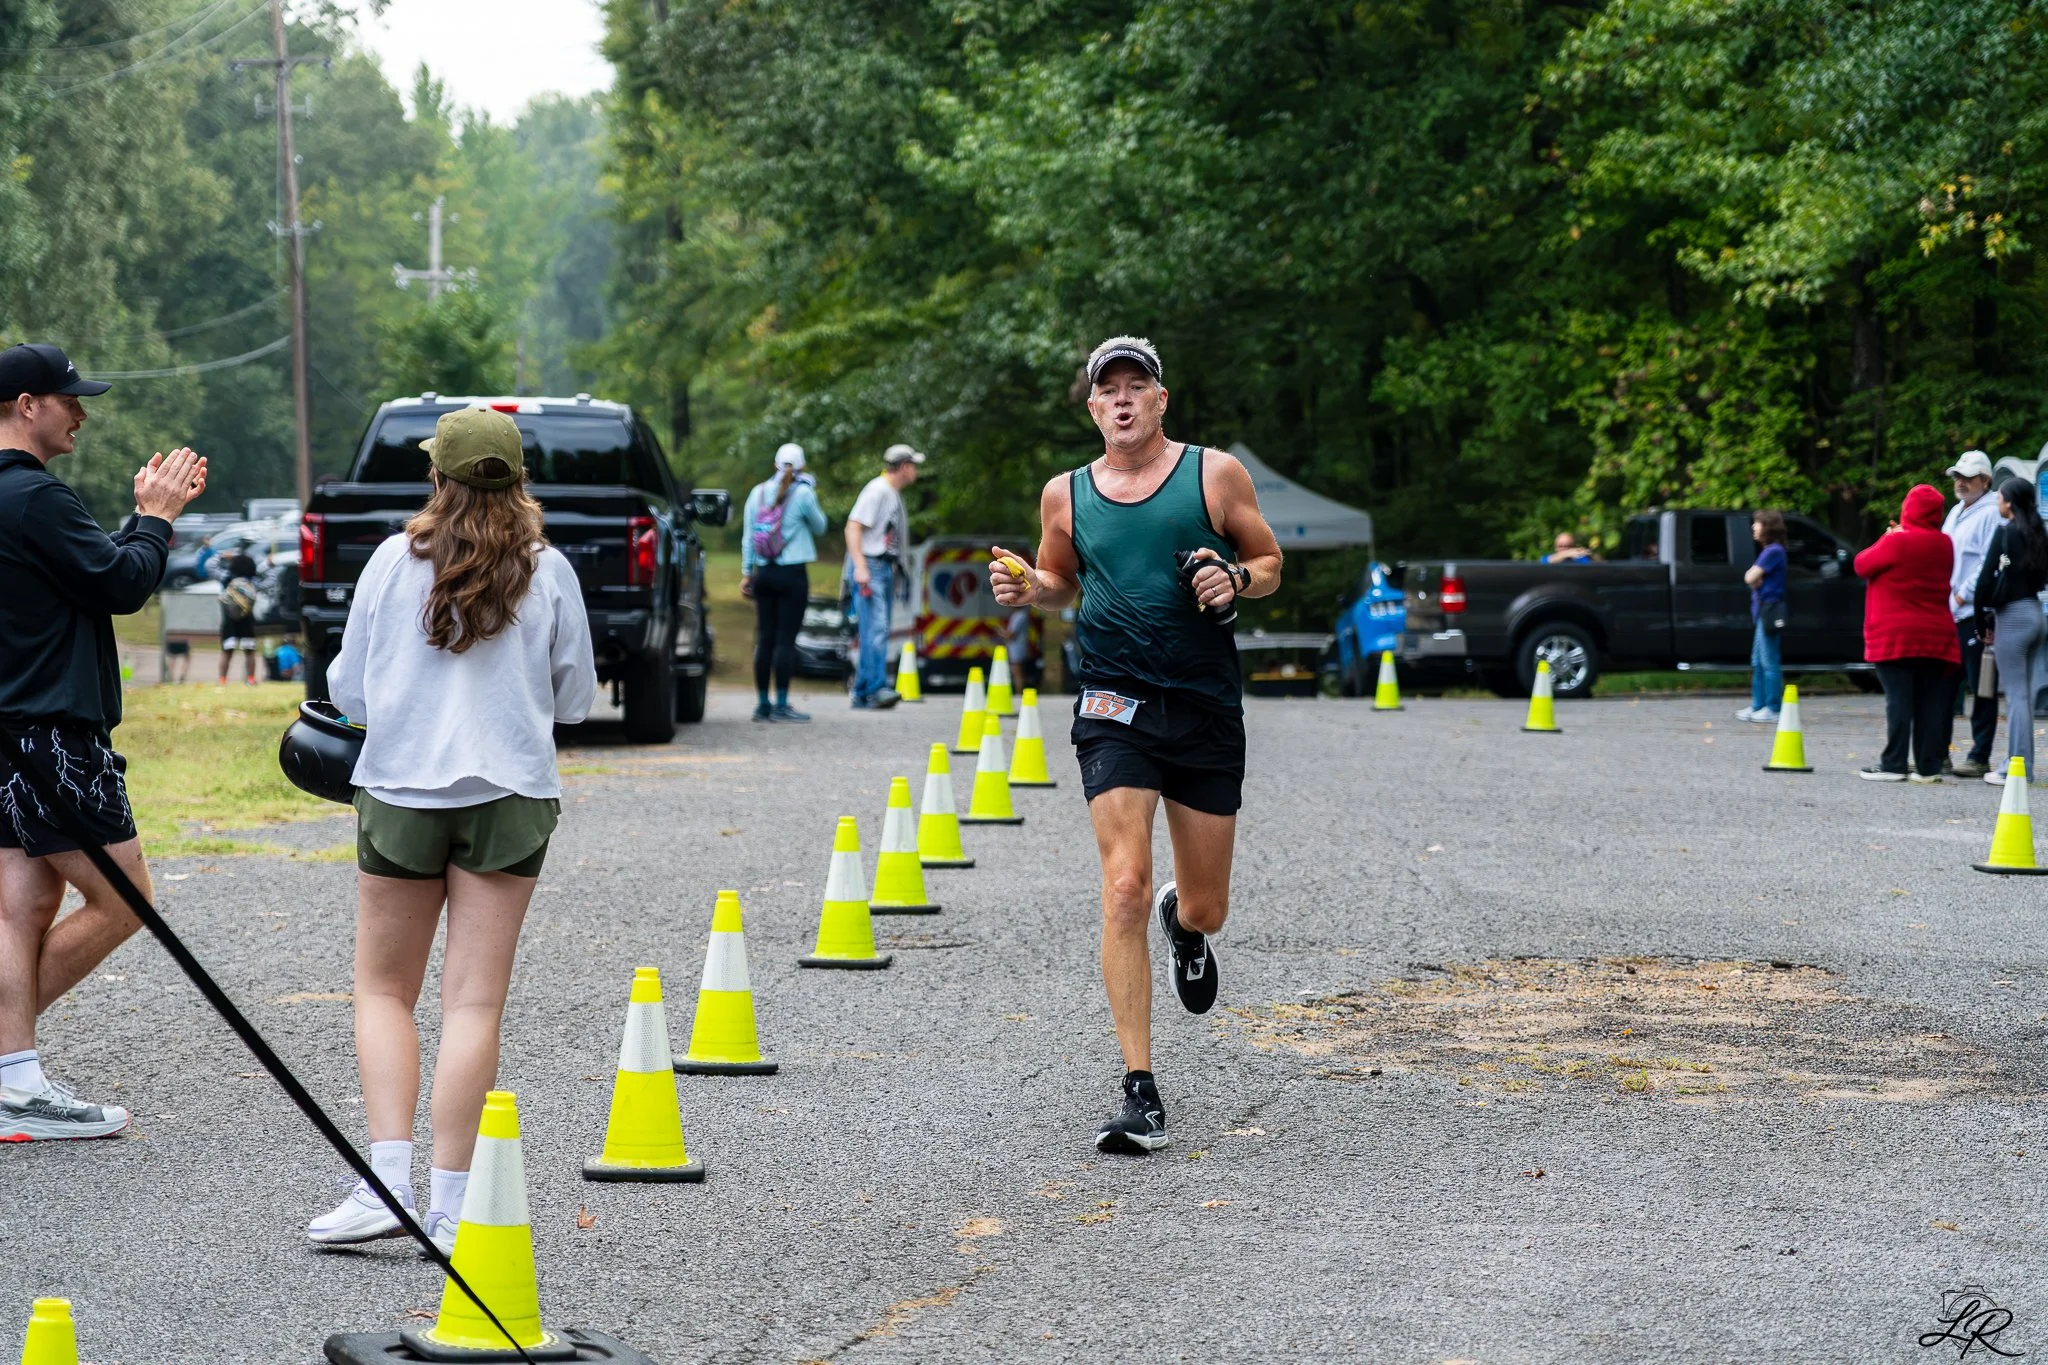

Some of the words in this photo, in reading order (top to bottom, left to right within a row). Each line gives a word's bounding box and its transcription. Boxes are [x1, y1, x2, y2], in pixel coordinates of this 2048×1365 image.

[1105, 349, 1129, 359] RAGNAR
[1129, 350, 1146, 361] TRAIL
[1095, 691, 1113, 701] Viking
[1113, 695, 1125, 705] Dad
[1085, 697, 1127, 718] 157
[35, 1104, 70, 1117] MATRYX
